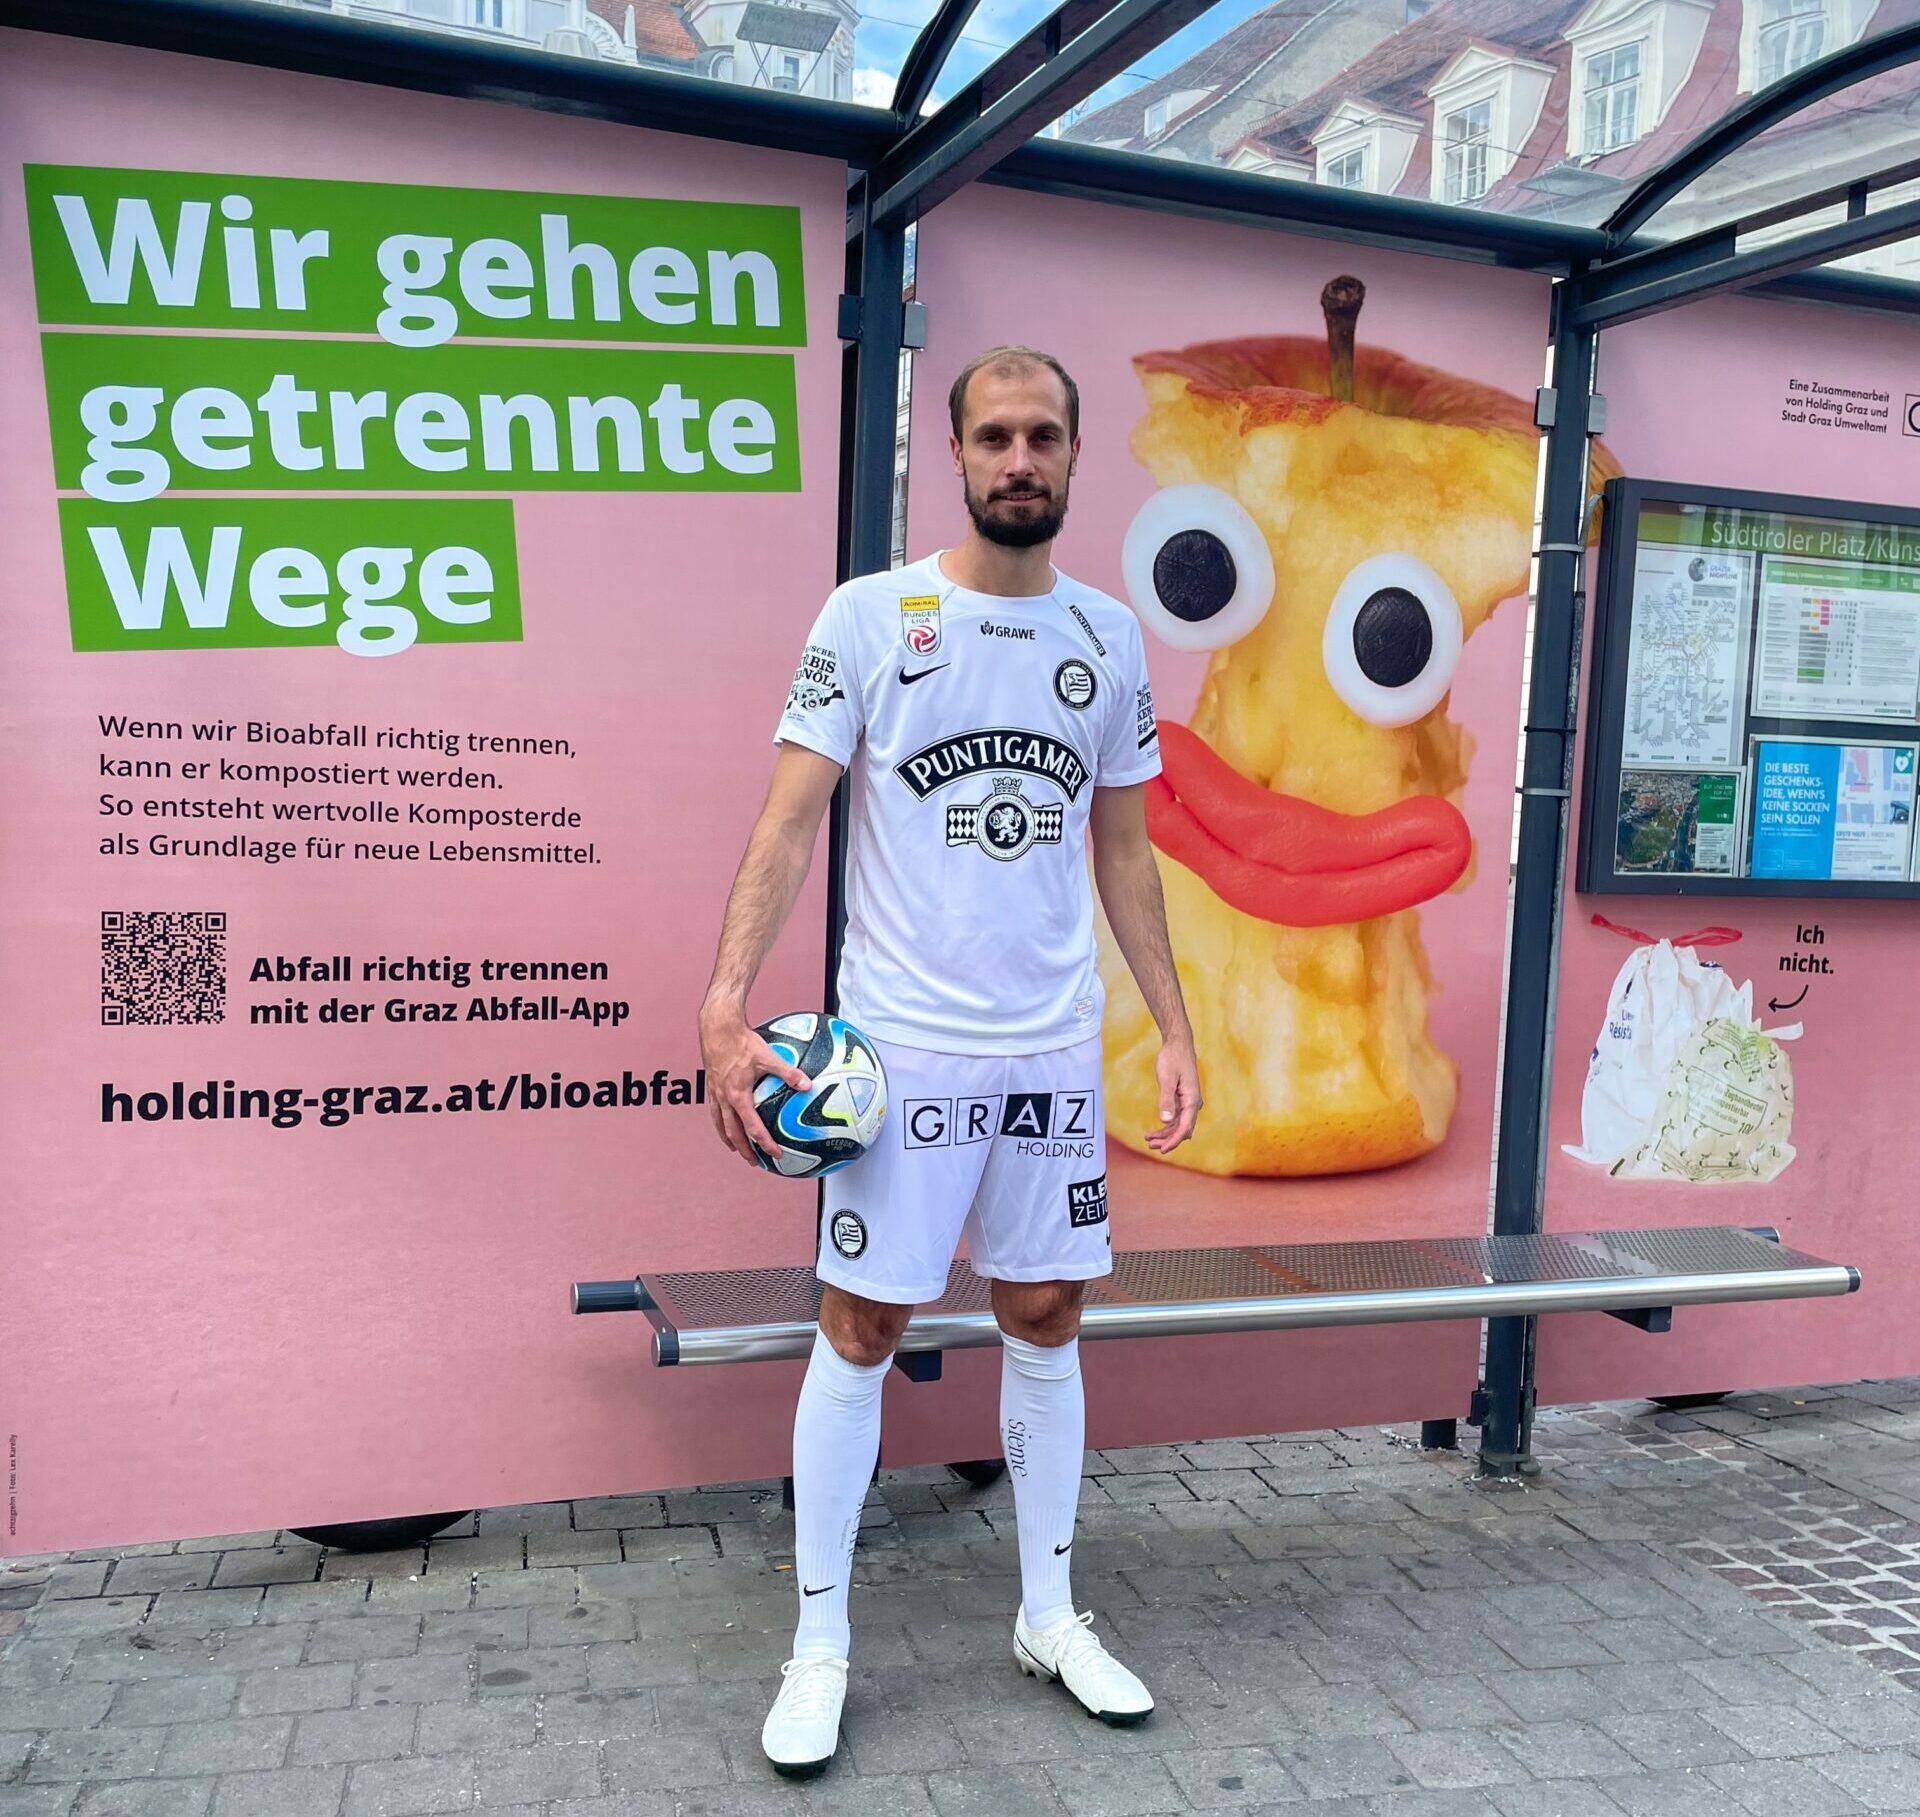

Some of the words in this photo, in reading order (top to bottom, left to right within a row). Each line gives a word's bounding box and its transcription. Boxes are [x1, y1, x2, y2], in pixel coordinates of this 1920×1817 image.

[52, 194, 329, 310] Wir
[376, 213, 781, 348] gehen
[1789, 379, 1809, 392] Eine
[1811, 382, 1890, 402] Zusammenarbeit
[1781, 409, 1806, 423] Stadt
[1808, 413, 1832, 427] Graz
[1834, 417, 1887, 433] Umweltamt
[1785, 397, 1803, 407] von
[1805, 397, 1843, 414] Holding
[1845, 402, 1869, 416] Graz
[1870, 407, 1889, 418] und
[79, 373, 777, 502] getrennte
[1711, 520, 1814, 552] Südtiroler
[86, 525, 495, 657] Wege
[903, 610, 938, 618] BUNDES
[995, 625, 1036, 640] GRAWE
[1070, 605, 1105, 656] PUNTIGAMER
[98, 715, 184, 739] Wenn
[192, 720, 237, 742] wir
[246, 721, 367, 748] Bioabfall
[376, 728, 461, 756] richtig
[467, 732, 577, 759] trennen,
[98, 753, 172, 779] kann
[181, 761, 210, 779] er
[219, 758, 390, 788] kompostiert
[397, 770, 504, 790] werden.
[907, 735, 1089, 796] PUNTIGAMER
[1764, 775, 1823, 787] GESCHENKS-
[1765, 762, 1780, 773] DIE
[1782, 763, 1810, 774] BESTE
[1761, 801, 1790, 812] KEINE
[1792, 802, 1830, 812] SOCKEN
[1763, 788, 1785, 800] IDEE,
[1788, 790, 1825, 800] WENN'S
[98, 794, 134, 817] So
[142, 795, 265, 821] entsteht
[272, 800, 400, 824] wertvolle
[408, 802, 582, 831] Komposterde
[1761, 813, 1783, 825] SEIN
[1786, 815, 1821, 825] SOLLEN
[98, 834, 139, 857] als
[148, 835, 297, 864] Grundlage
[305, 837, 345, 860] für
[353, 843, 420, 861] neue
[428, 840, 602, 865] Lebensmittel.
[1796, 924, 1825, 944] Ich
[249, 956, 351, 983] Abfall
[362, 956, 471, 988] richtig
[481, 957, 609, 982] trennen
[1779, 952, 1834, 974] nicht.
[250, 997, 309, 1024] mit
[318, 998, 375, 1023] der
[384, 997, 458, 1022] Graz
[466, 997, 630, 1028] Abfall-App
[101, 1069, 706, 1129] holding-graz.at/bioabfal
[910, 1096, 1088, 1144] GRAZ
[1017, 1140, 1095, 1158] HOLDING
